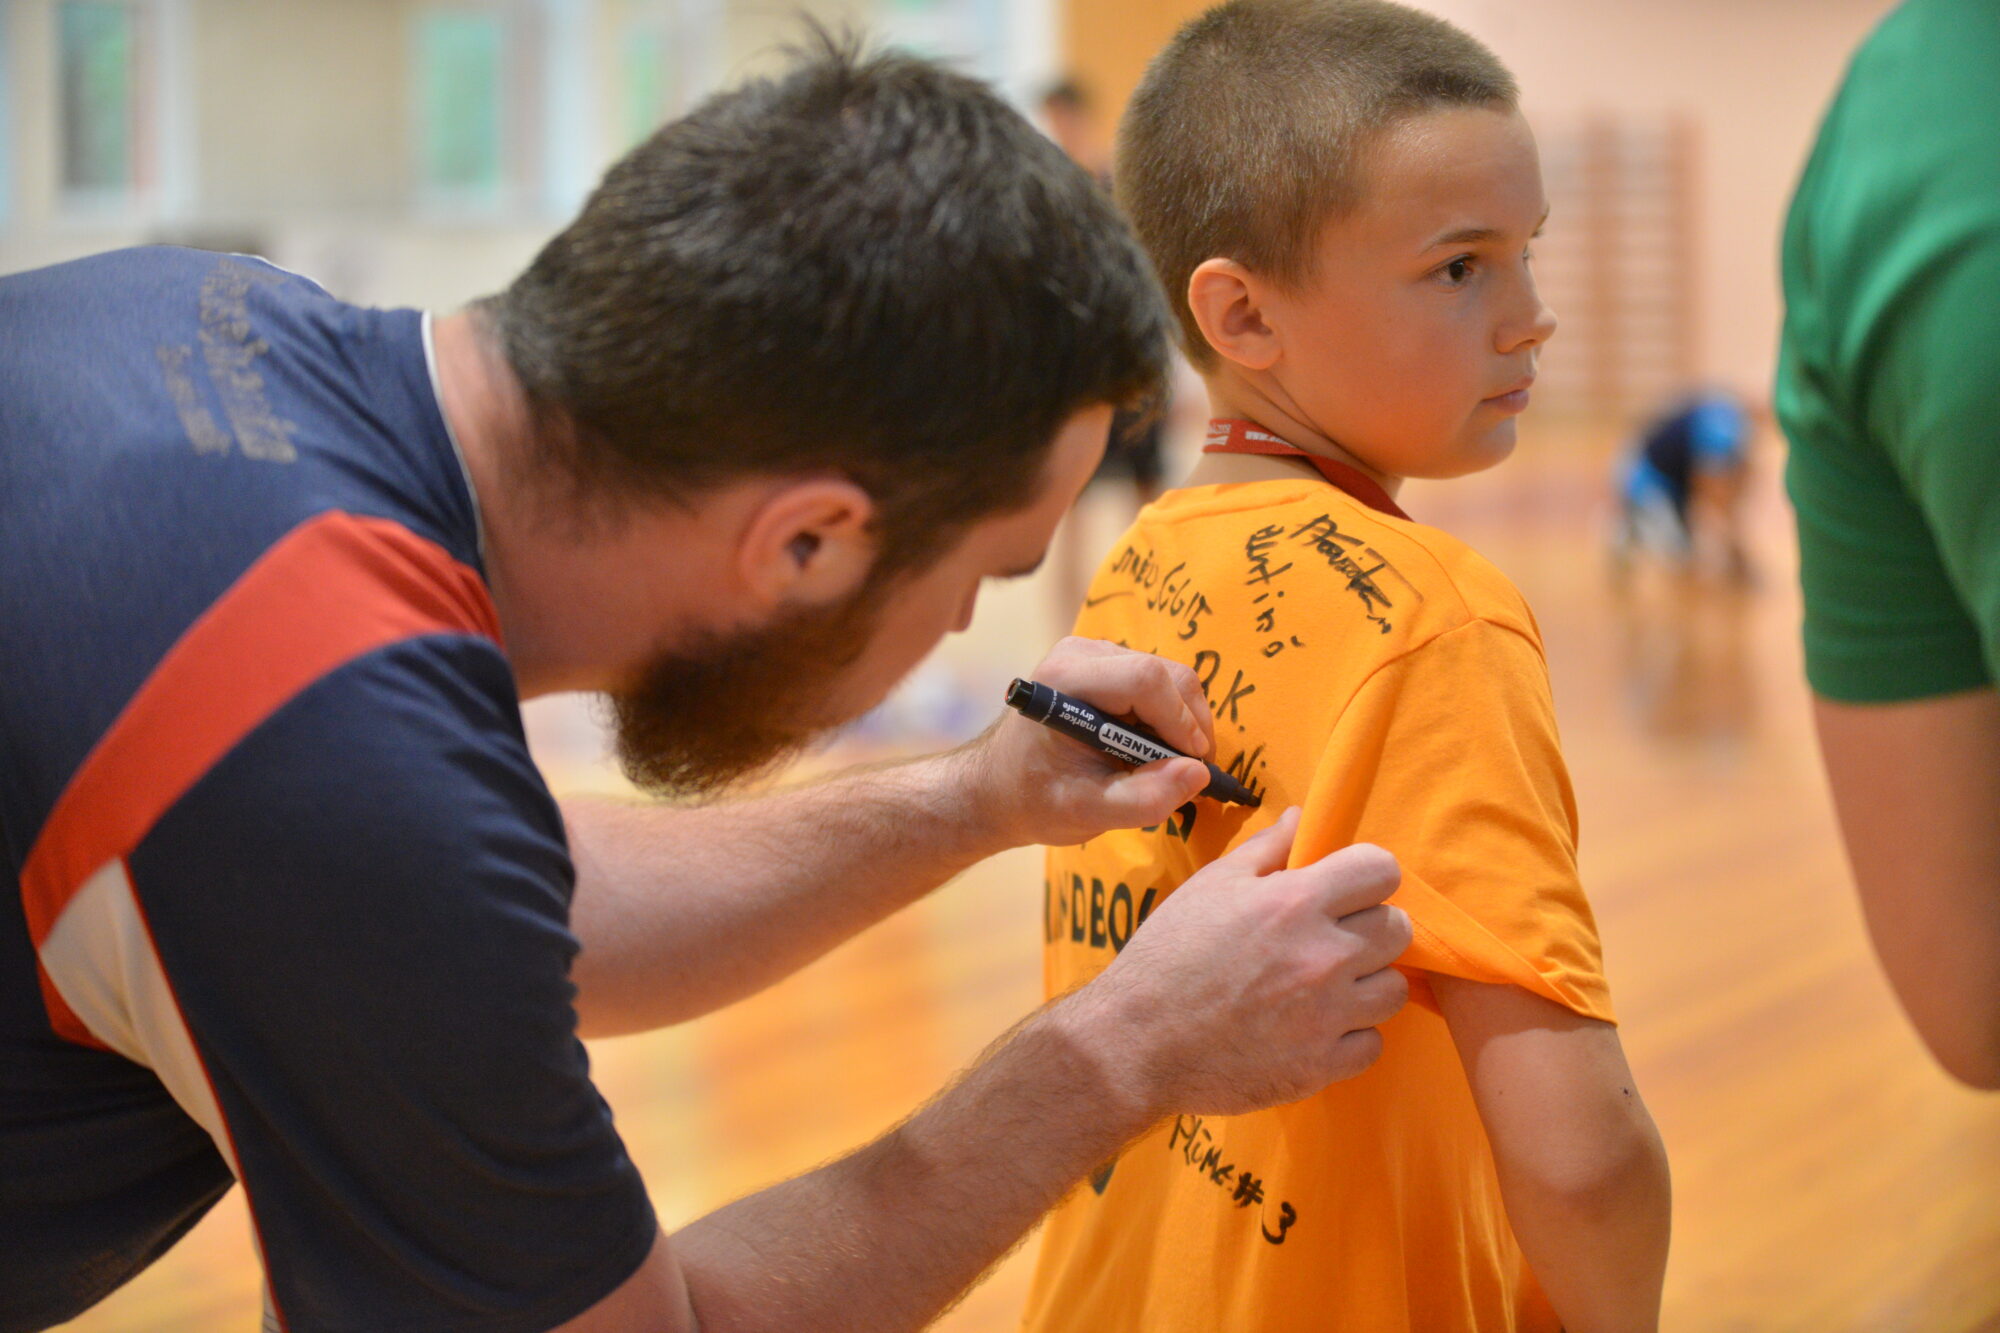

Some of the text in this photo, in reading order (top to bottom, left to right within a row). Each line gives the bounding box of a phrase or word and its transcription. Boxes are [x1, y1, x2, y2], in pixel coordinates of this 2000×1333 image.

[1058, 711, 1098, 733] marker
[1062, 701, 1096, 722] dry safe
